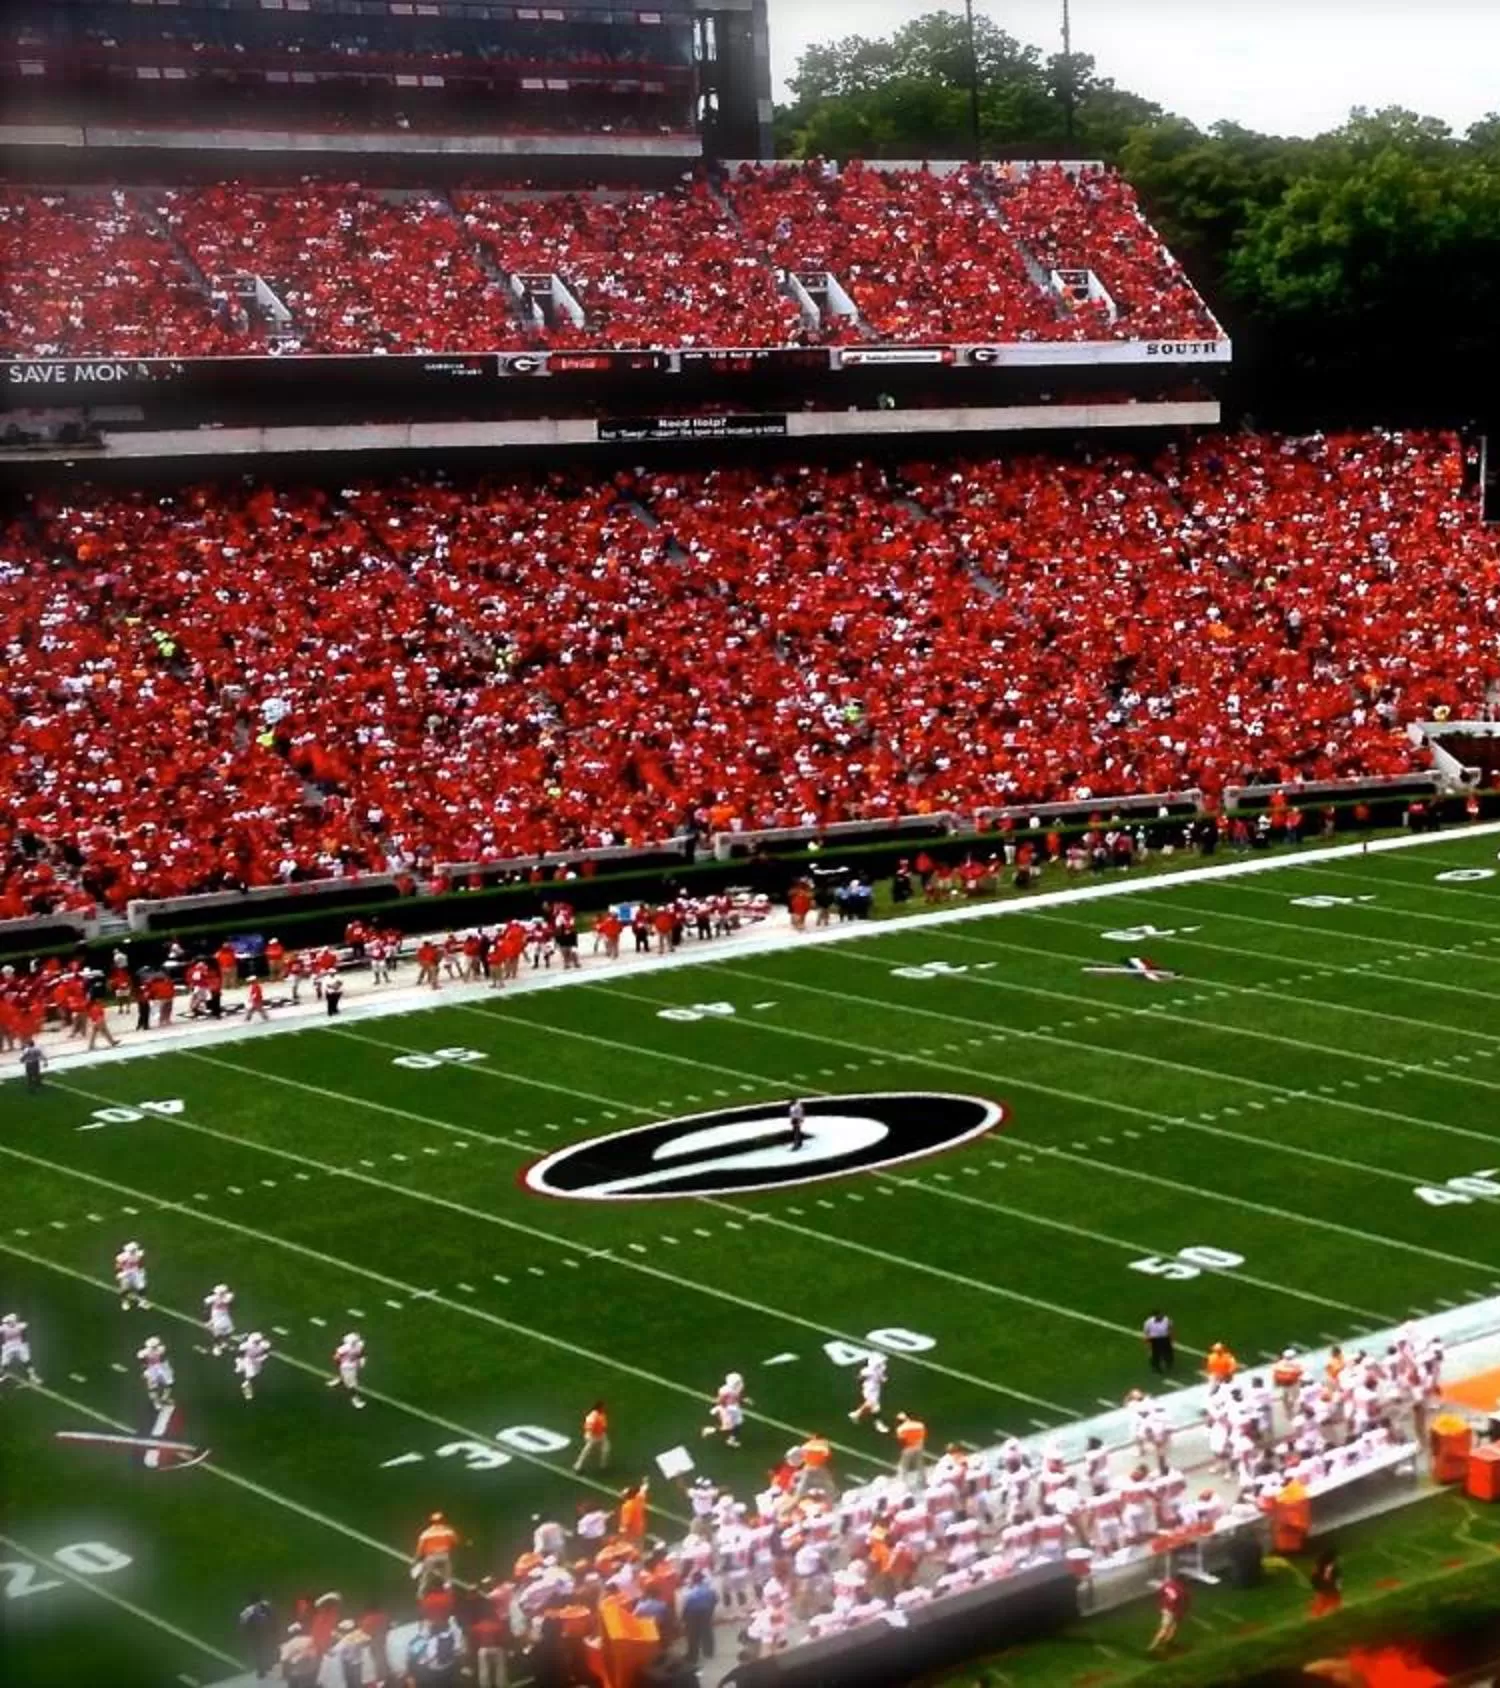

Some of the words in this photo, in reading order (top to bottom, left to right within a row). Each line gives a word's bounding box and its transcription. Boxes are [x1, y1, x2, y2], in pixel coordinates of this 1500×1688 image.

[1146, 342, 1217, 355] SOUTH
[9, 364, 67, 383] SAVE
[1127, 1246, 1245, 1280] 50
[822, 1328, 937, 1366] 40
[435, 1424, 572, 1471] 30
[0, 1541, 133, 1600] 20
